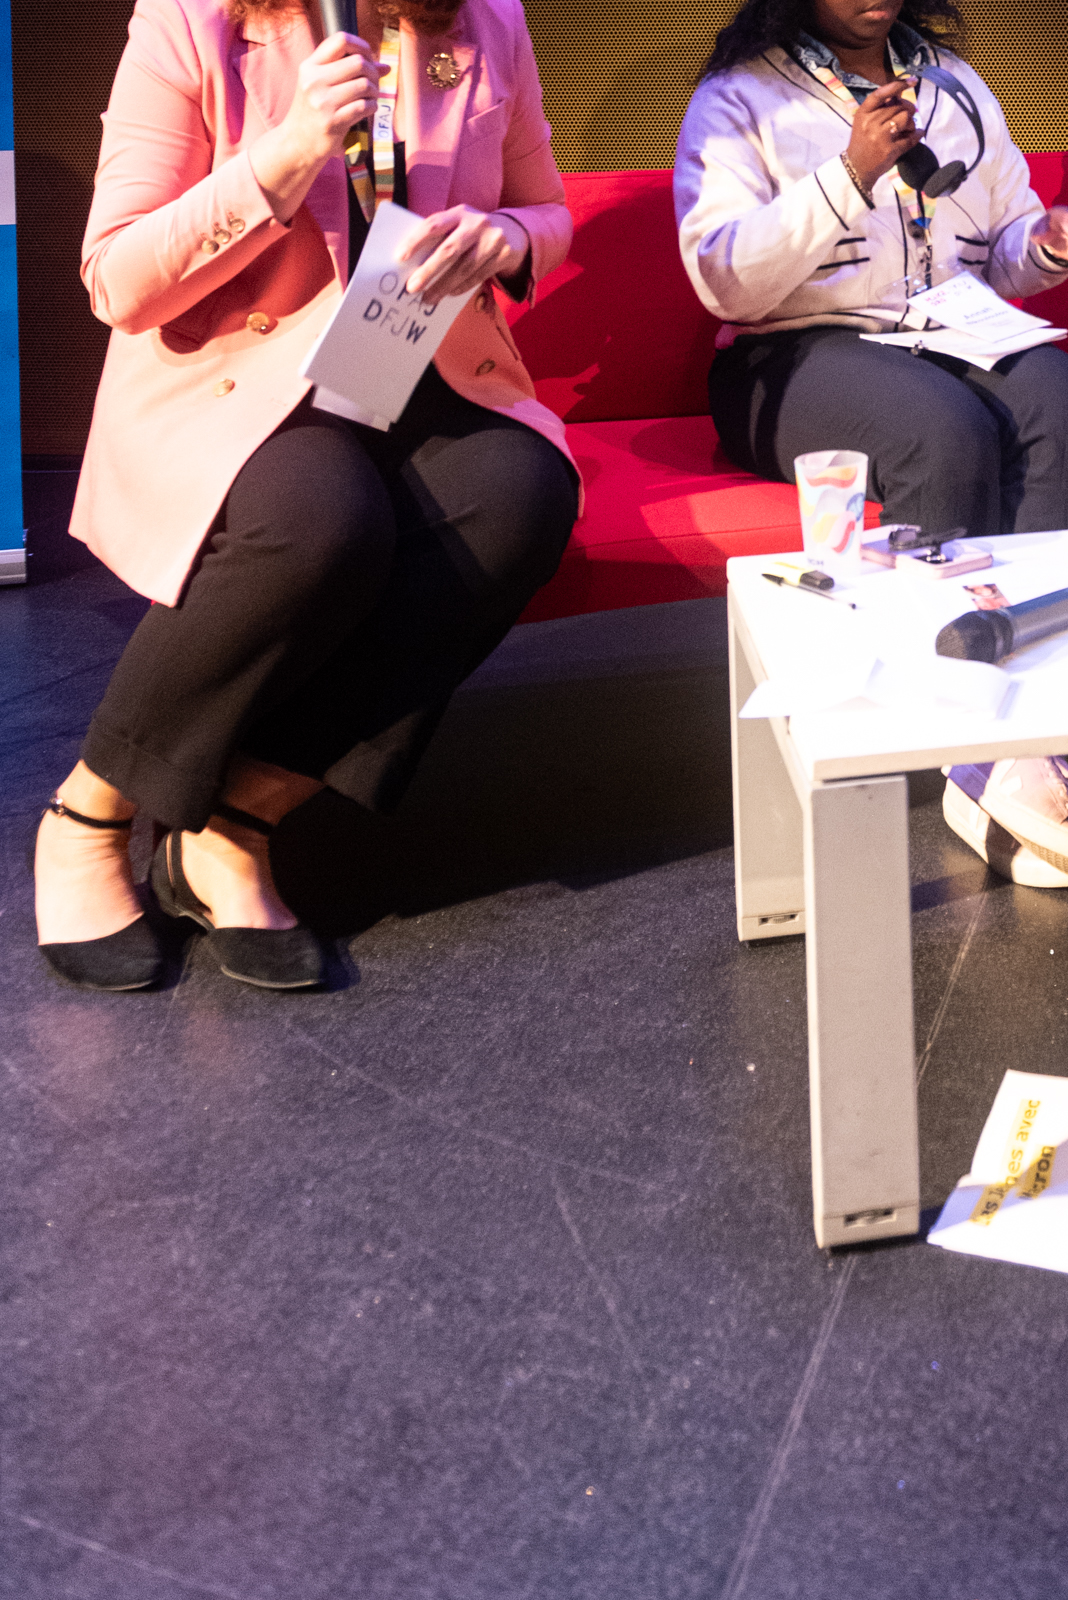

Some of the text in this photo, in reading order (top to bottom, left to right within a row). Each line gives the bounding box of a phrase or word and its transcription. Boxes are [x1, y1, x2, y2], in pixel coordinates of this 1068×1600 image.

[377, 104, 391, 138] OFAJ
[363, 298, 428, 345] DFJW
[1015, 1099, 1042, 1142] avec
